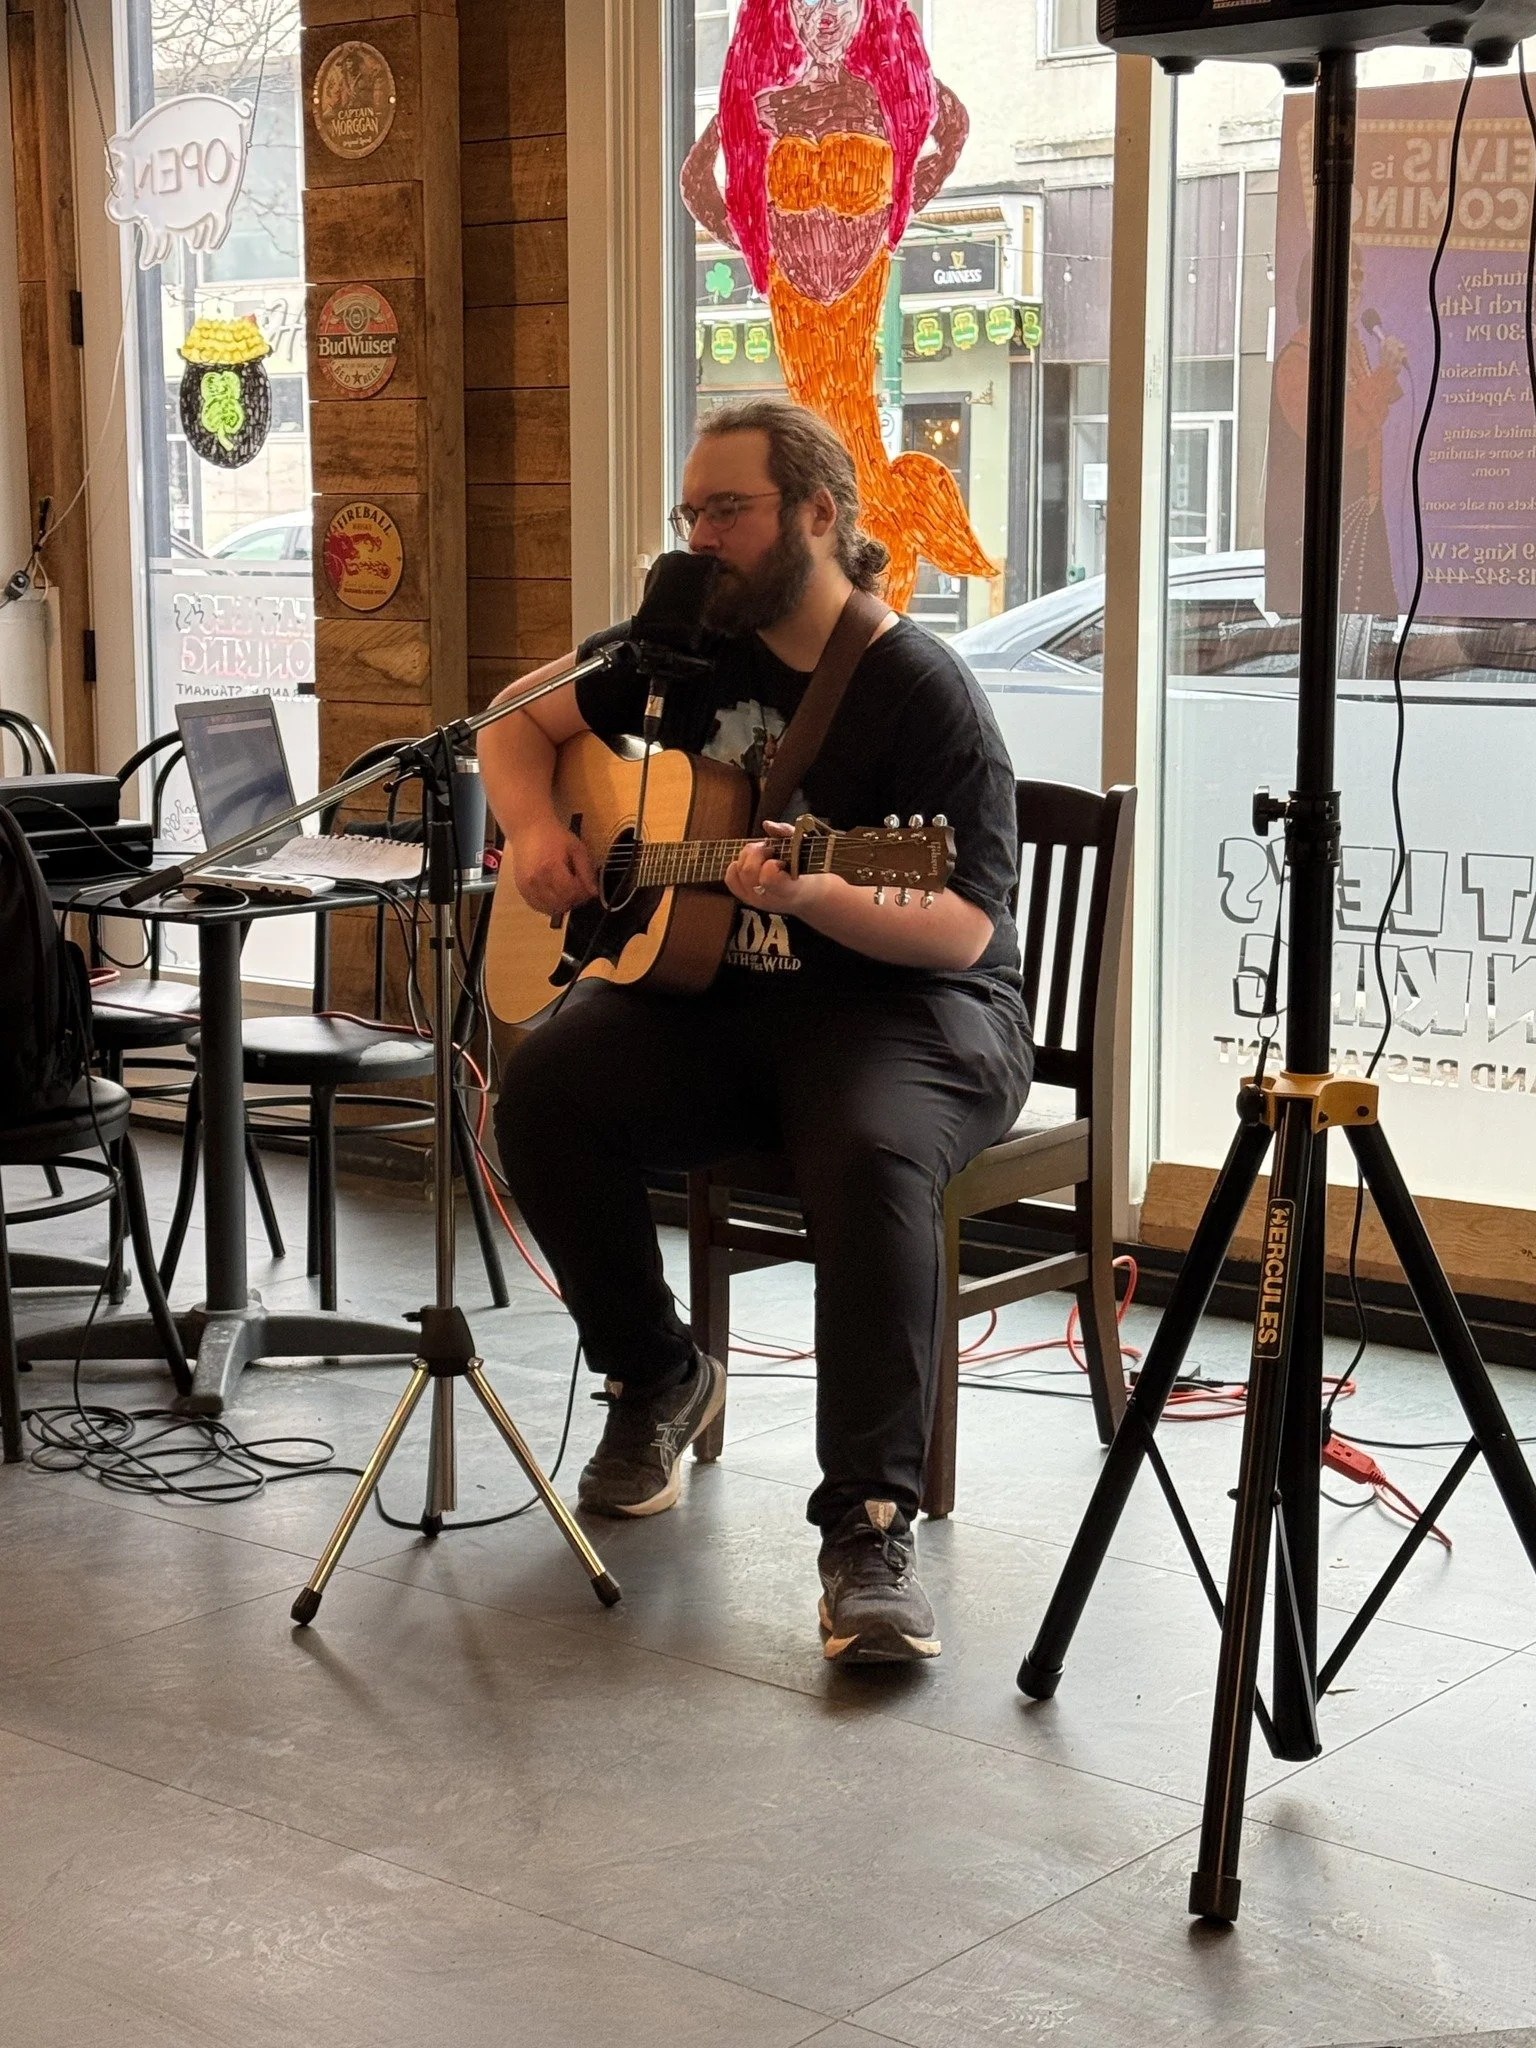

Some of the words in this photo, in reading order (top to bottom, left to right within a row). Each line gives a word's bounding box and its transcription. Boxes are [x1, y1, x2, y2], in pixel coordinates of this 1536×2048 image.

[338, 107, 374, 120] CAPTAIN
[933, 269, 982, 285] GUINNESS
[336, 506, 393, 536] FIREBALL
[761, 955, 802, 973] WILD
[1257, 1206, 1290, 1344] HERCULES
